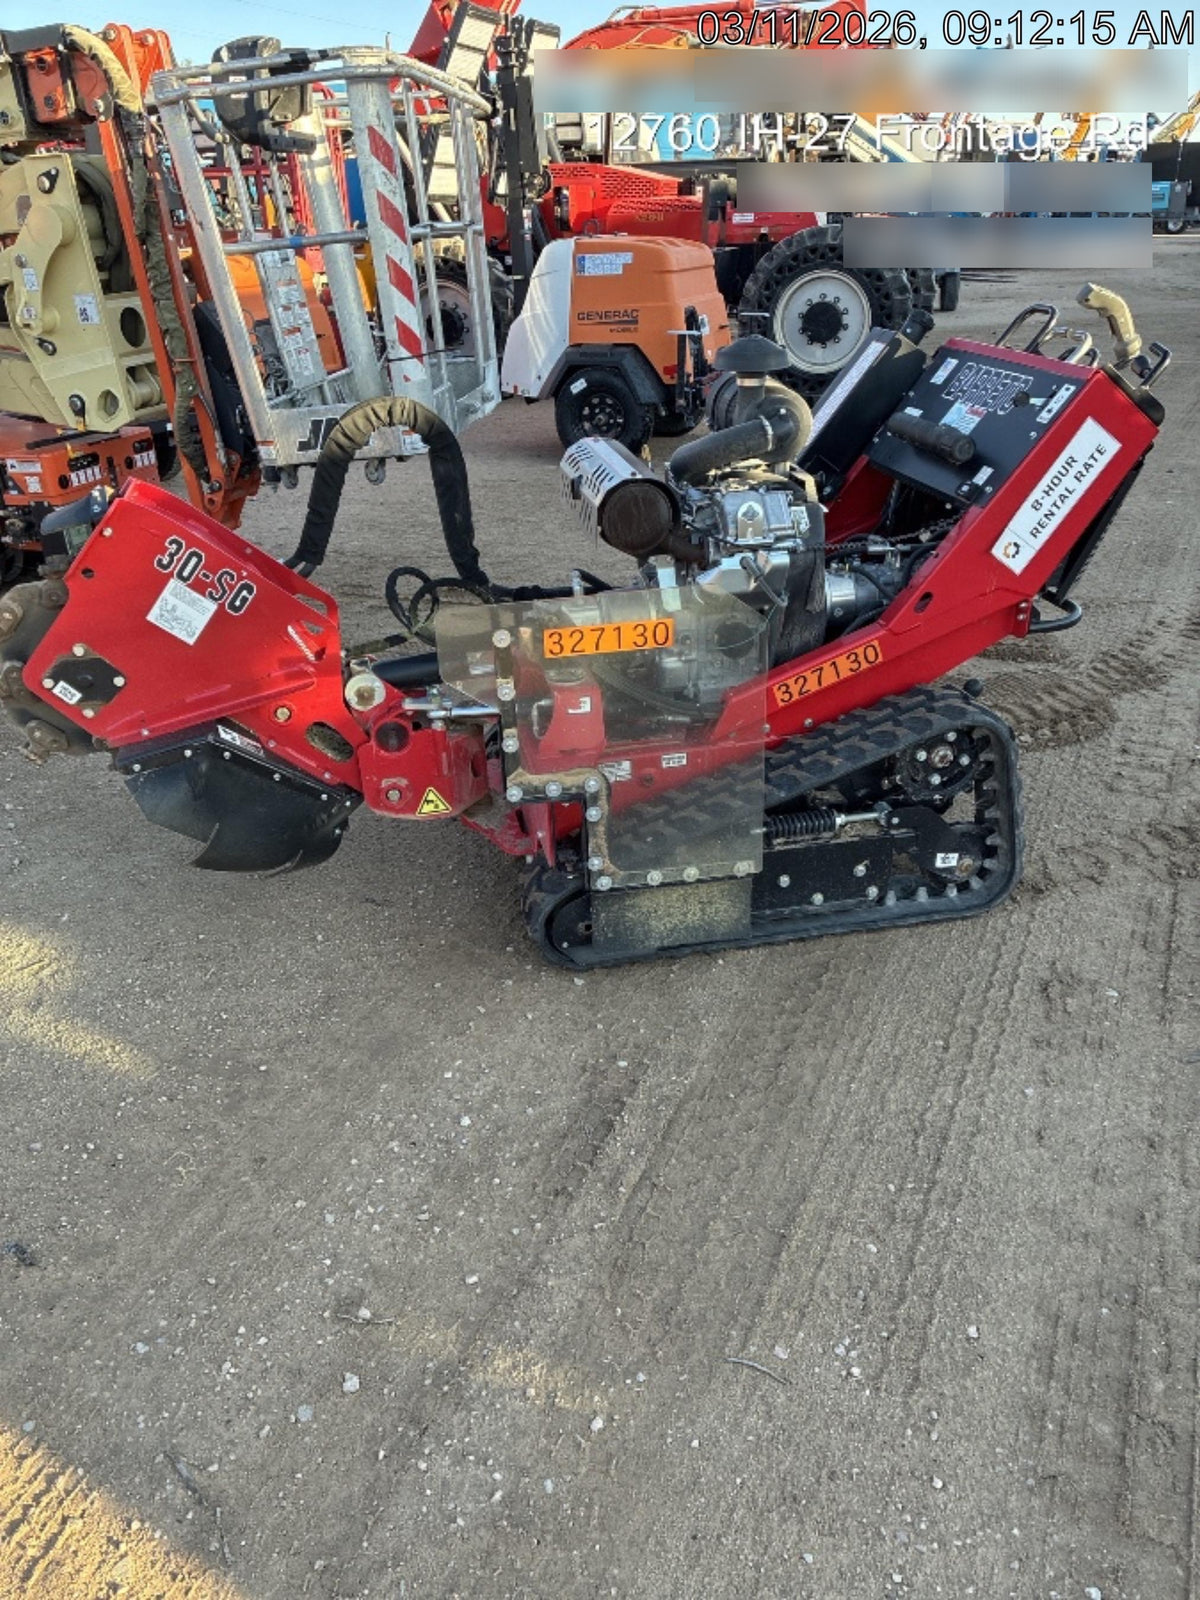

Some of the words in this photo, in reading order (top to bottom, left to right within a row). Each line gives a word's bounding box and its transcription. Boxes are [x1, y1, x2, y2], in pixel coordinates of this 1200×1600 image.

[577, 309, 639, 321] GENERAC
[1029, 486, 1076, 539] RENTAL
[1074, 444, 1107, 483] RATE
[1031, 455, 1078, 512] 8-HOUR
[154, 535, 256, 615] 30-SG
[548, 621, 670, 656] 327130
[777, 643, 880, 703] 327130
